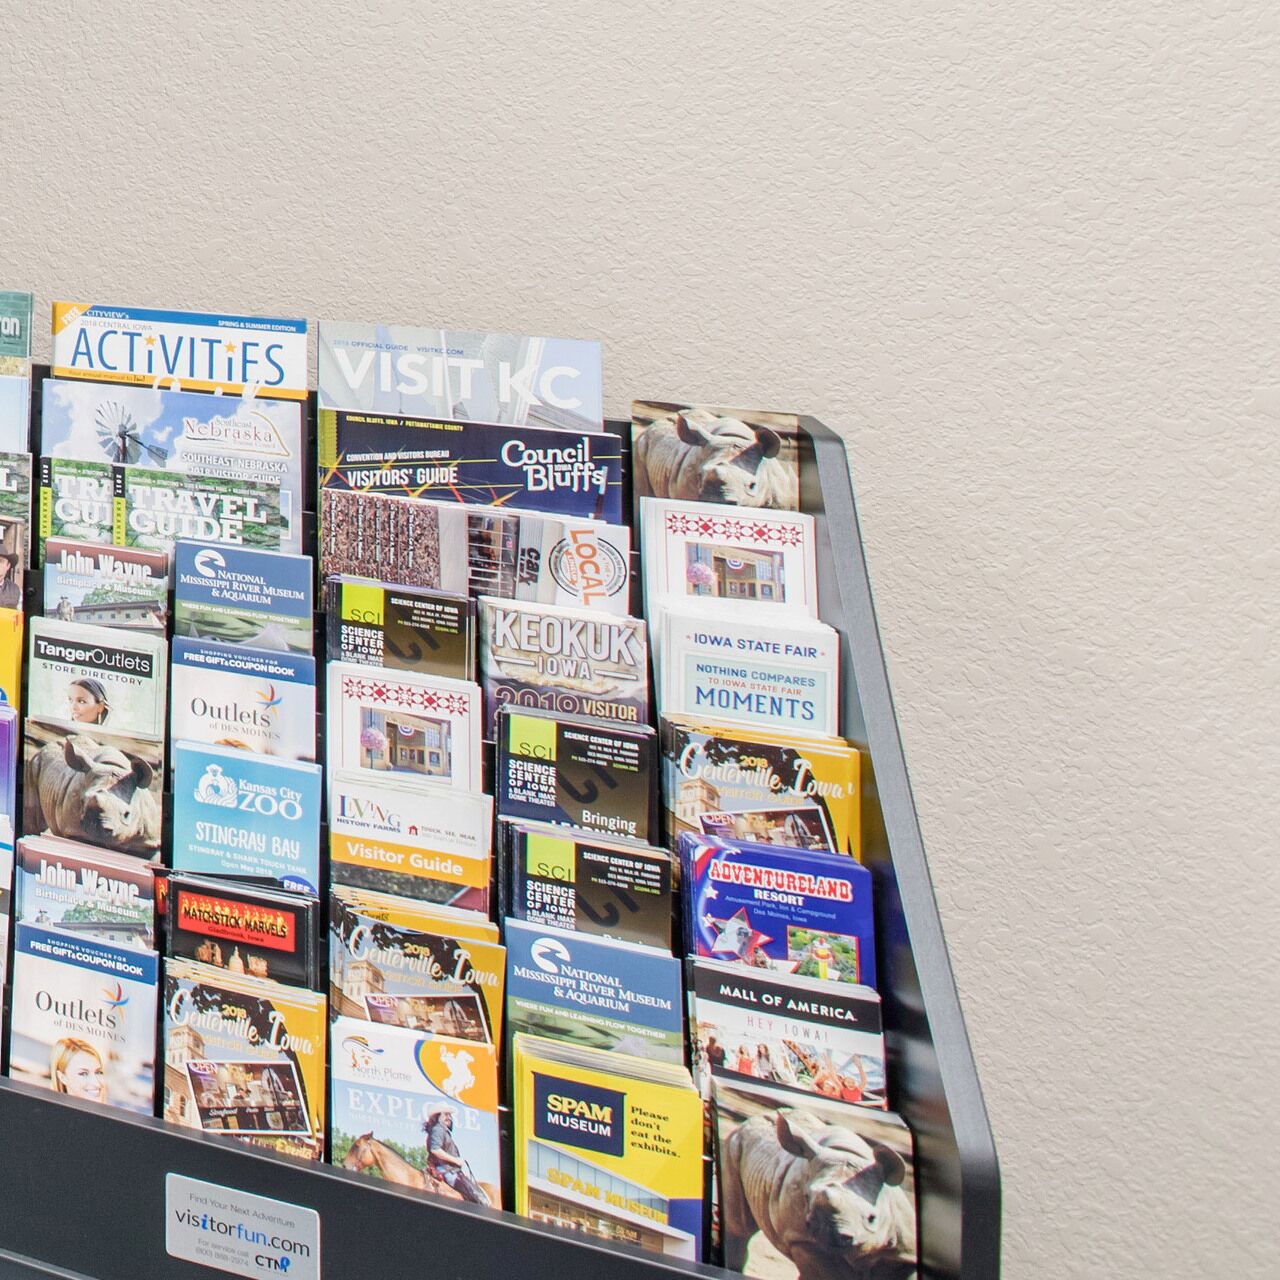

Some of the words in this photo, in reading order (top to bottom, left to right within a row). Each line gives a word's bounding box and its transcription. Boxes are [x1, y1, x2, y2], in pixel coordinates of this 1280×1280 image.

[335, 348, 484, 400] VISIT
[498, 360, 583, 409] KC
[346, 452, 382, 462] CONVENTION
[397, 451, 424, 459] VISITORS
[425, 450, 450, 458] BUREAU
[501, 437, 590, 467] Council
[182, 453, 235, 468] SOUTHEAST
[238, 457, 288, 473] NEBRASKA
[417, 467, 458, 484] GUIDE
[128, 484, 267, 524] TRAVEL
[128, 508, 243, 545] GUIDE
[181, 574, 230, 589] MISSISSIPPI
[232, 579, 261, 594] RIVER
[263, 585, 305, 600] MUSEUM
[218, 570, 266, 585] NATIONAL
[212, 589, 220, 597] &
[221, 590, 271, 605] AQUARIUM
[391, 597, 413, 607] SCIENCE
[414, 601, 435, 611] CENTER
[444, 606, 459, 614] IOWA
[341, 625, 384, 640] SCIENCE
[341, 634, 384, 649] CENTER
[495, 609, 636, 666] KEOKUK
[341, 643, 353, 651] OF
[358, 646, 383, 656] IOWA
[694, 632, 732, 648] IOWA
[737, 638, 780, 654] STATE
[785, 645, 817, 658] FAIR
[184, 653, 204, 664] FREE
[200, 649, 236, 658] SHOPPING
[238, 653, 265, 662] VOUCHER
[42, 662, 76, 675] STORE
[81, 669, 143, 686] DIRECTORY
[539, 655, 591, 680] IOWA
[696, 664, 747, 678] NOTHING
[751, 671, 815, 687] COMPARES
[708, 677, 719, 685] TO
[722, 679, 746, 689] IOWA
[750, 683, 777, 693] STATE
[781, 688, 802, 696] FAIR
[191, 697, 271, 728] Outlets
[582, 699, 638, 721] VISITOR
[696, 685, 815, 721] MOMENTS
[221, 724, 240, 734] DES
[564, 731, 589, 742] SCIENCE
[590, 736, 613, 745] CENTER
[623, 741, 639, 750] IOWA
[509, 759, 556, 776] SCIENCE
[509, 769, 556, 786] CENTER
[239, 779, 277, 797] Kansas
[280, 786, 302, 801] City
[509, 779, 523, 787] OF
[527, 783, 556, 793] IOWA
[239, 791, 303, 820] ZOO
[528, 797, 556, 807] THEATER
[337, 818, 371, 828] HISTORY
[373, 824, 401, 834] FARMS
[582, 810, 637, 833] Bringing
[196, 821, 266, 852] STINGRAY
[221, 860, 240, 870] Open
[287, 864, 307, 874] TANK
[347, 842, 405, 864] Visitor
[409, 854, 463, 876] Guide
[583, 852, 609, 863] SCIENCE
[610, 856, 634, 868] CENTER
[634, 861, 643, 869] OF
[644, 863, 661, 873] IOWA
[526, 880, 576, 898] SCIENCE
[709, 860, 853, 902] ADVENTURELAND
[526, 890, 576, 908] CENTER
[754, 889, 804, 906] RESORT
[527, 900, 541, 909] OF
[546, 904, 576, 916] IOWA
[792, 915, 807, 923] Iowa
[30, 941, 51, 954] FREE
[116, 961, 143, 976] BOOK
[561, 965, 622, 988] NATIONAL
[553, 987, 564, 997] &
[566, 991, 630, 1013] AQUARIUM
[580, 980, 615, 997] RIVER
[618, 989, 672, 1010] MUSEUM
[720, 984, 758, 1002] MALL
[762, 994, 783, 1007] OF
[36, 991, 116, 1029] Outlets
[747, 1016, 774, 1031] HEY
[547, 1094, 613, 1124] SPAM
[630, 1106, 669, 1122] Please
[547, 1112, 611, 1137] MUSEUM
[630, 1131, 650, 1139] eat
[653, 1134, 672, 1145] the
[210, 1200, 227, 1210] Your
[176, 1209, 309, 1257] visitorfun.com
